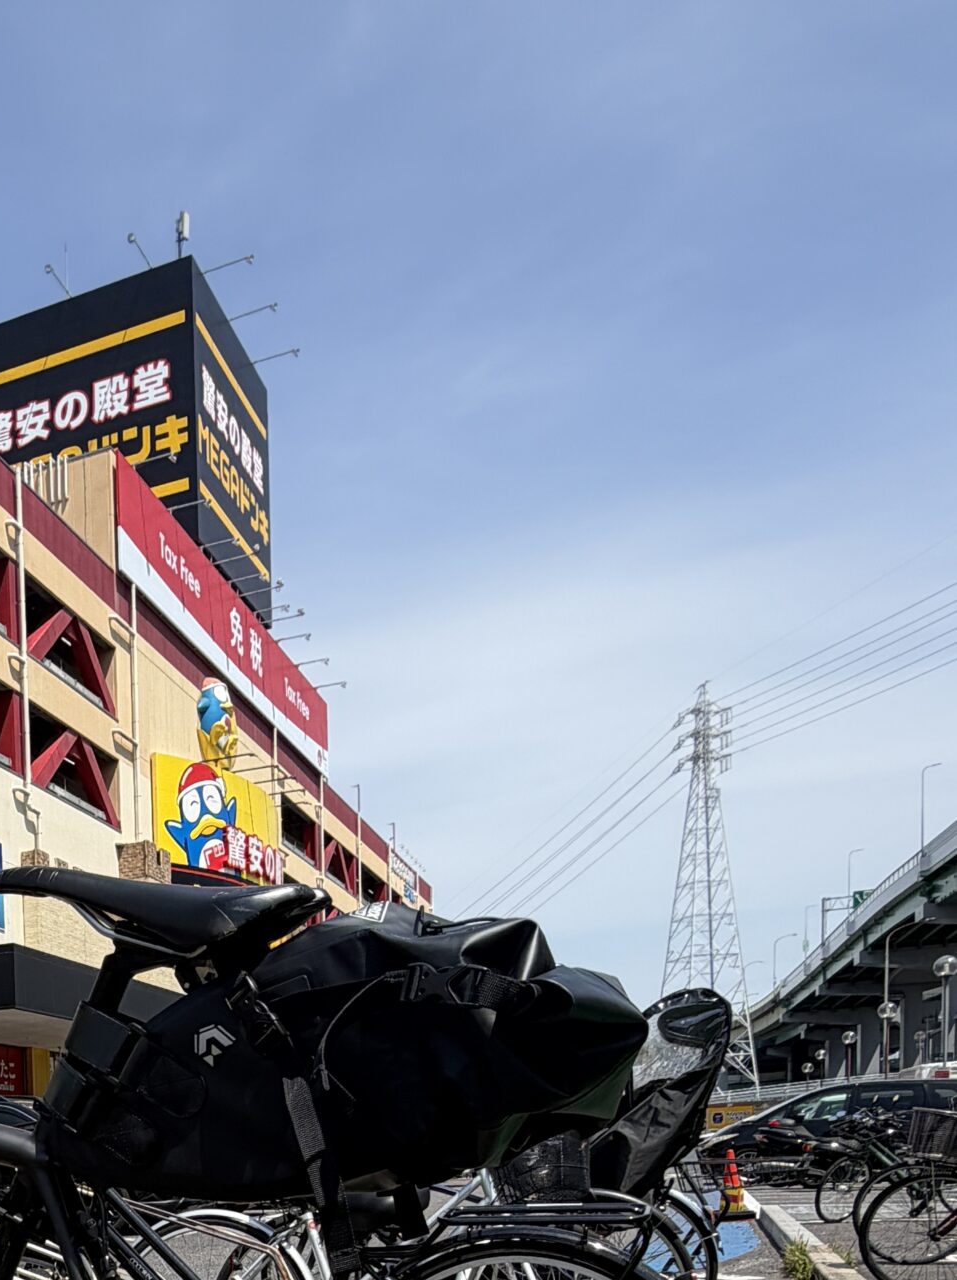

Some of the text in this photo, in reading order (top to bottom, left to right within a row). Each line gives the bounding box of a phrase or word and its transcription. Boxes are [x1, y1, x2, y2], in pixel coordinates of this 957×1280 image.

[201, 363, 264, 496] 驚安の殿堂
[197, 413, 269, 547] MEGAドンキ
[159, 531, 201, 598] Tax Free
[229, 606, 264, 678] 免税
[284, 676, 310, 720] Tax Free
